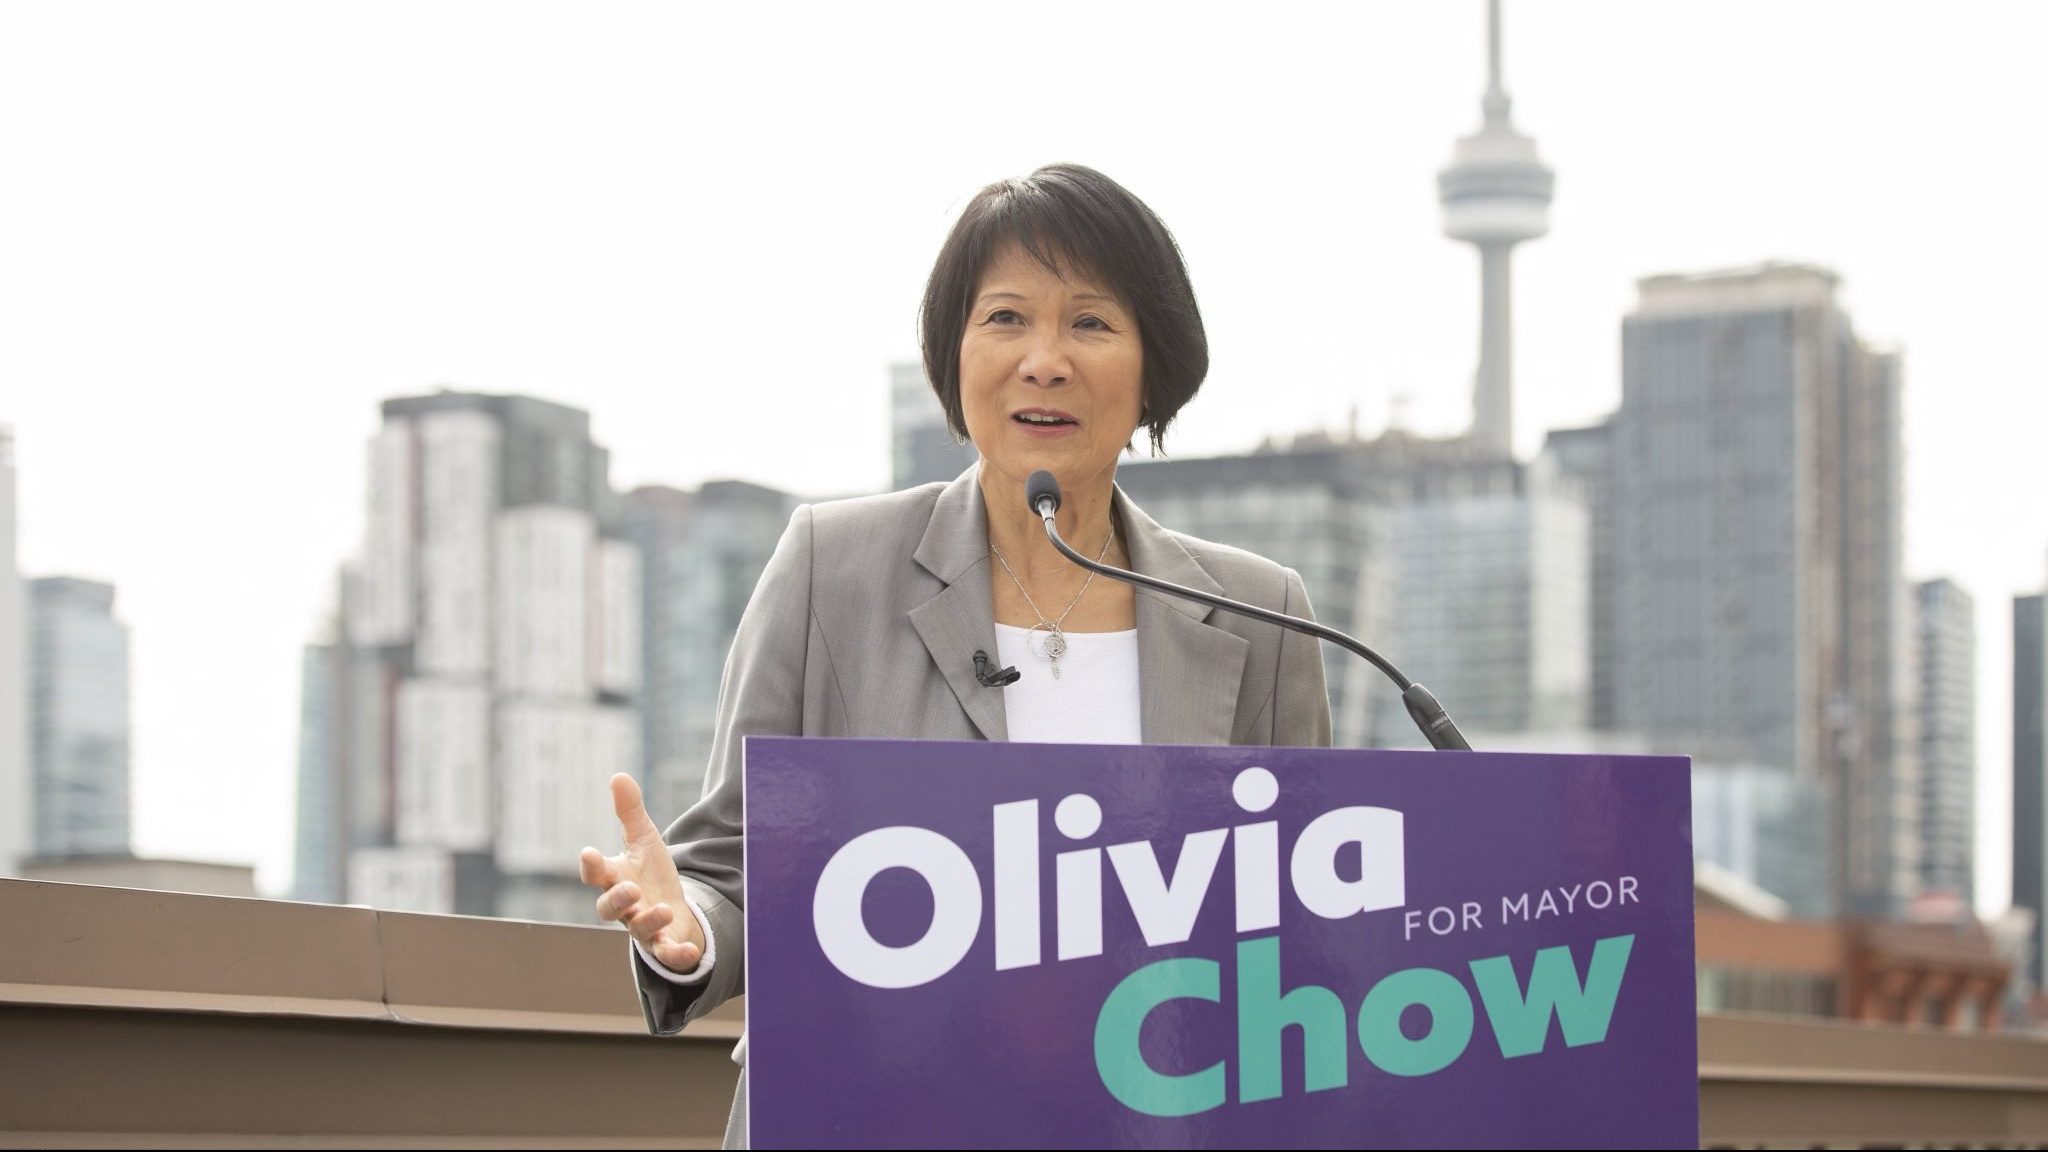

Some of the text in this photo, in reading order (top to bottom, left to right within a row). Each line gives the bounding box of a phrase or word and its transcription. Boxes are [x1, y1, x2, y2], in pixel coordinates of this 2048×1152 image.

[812, 766, 1406, 990] Olivia
[1404, 876, 1640, 941] FOR MAYOR
[1093, 934, 1636, 1118] Chow
